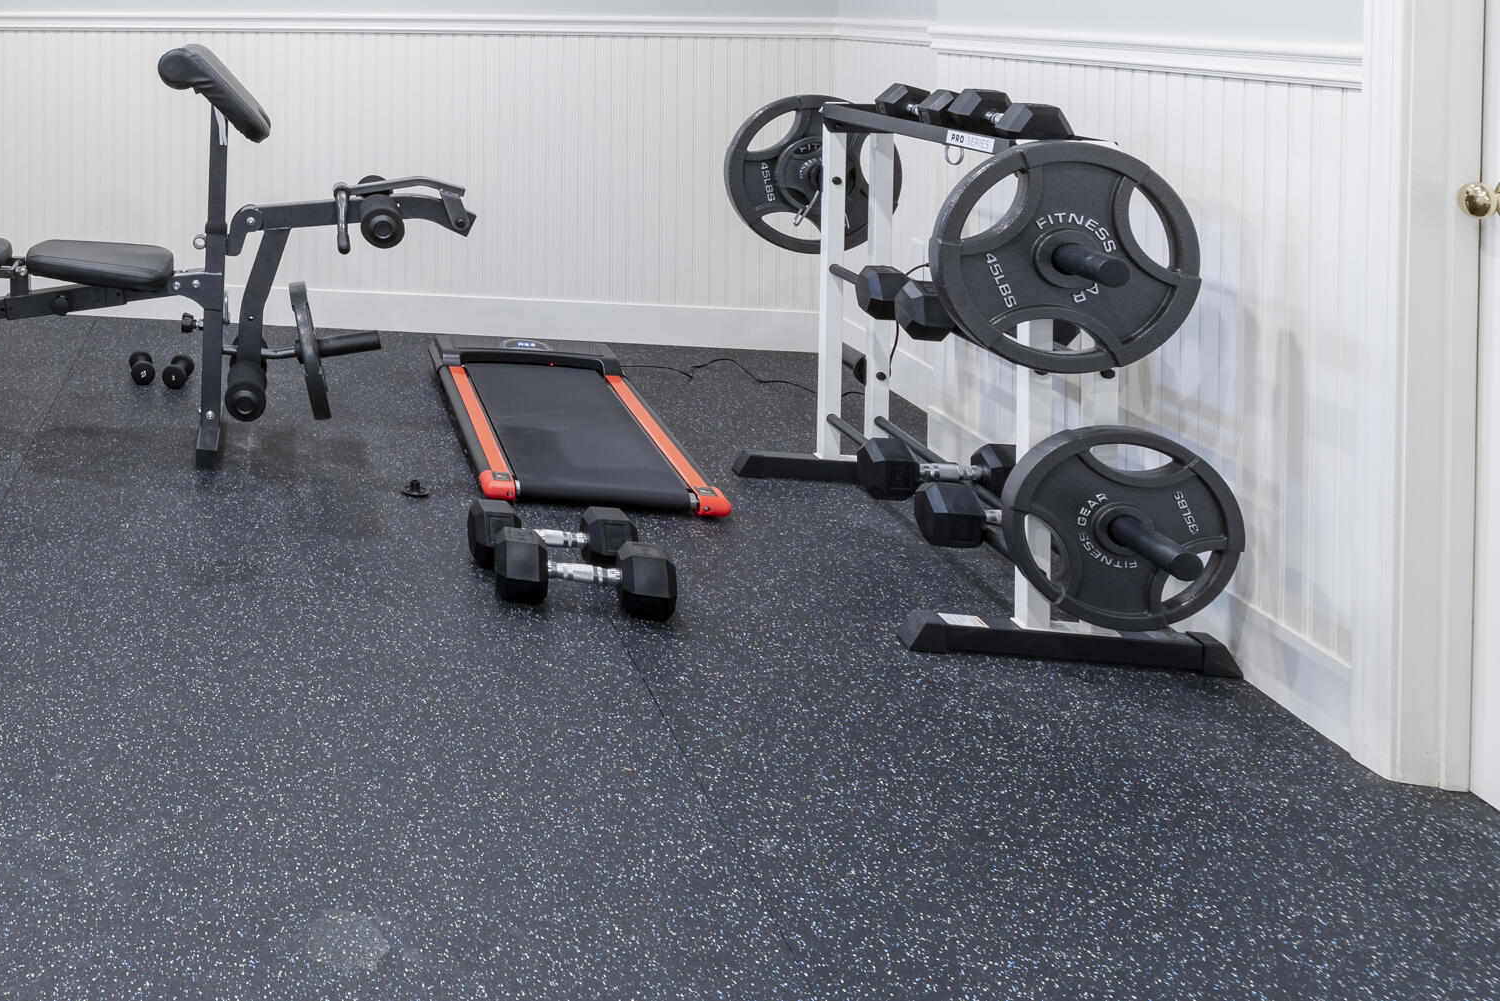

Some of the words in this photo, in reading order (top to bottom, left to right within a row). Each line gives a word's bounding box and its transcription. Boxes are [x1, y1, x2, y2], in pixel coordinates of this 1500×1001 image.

[951, 133, 965, 143] PRO
[966, 136, 990, 149] SERIES
[761, 162, 775, 201] 45LBS
[1036, 212, 1117, 253] FITNESS
[985, 253, 1017, 308] 45LBS
[1077, 493, 1108, 526] GEAR
[1174, 490, 1199, 535] 35LBS
[1078, 532, 1138, 569] FITNESS
